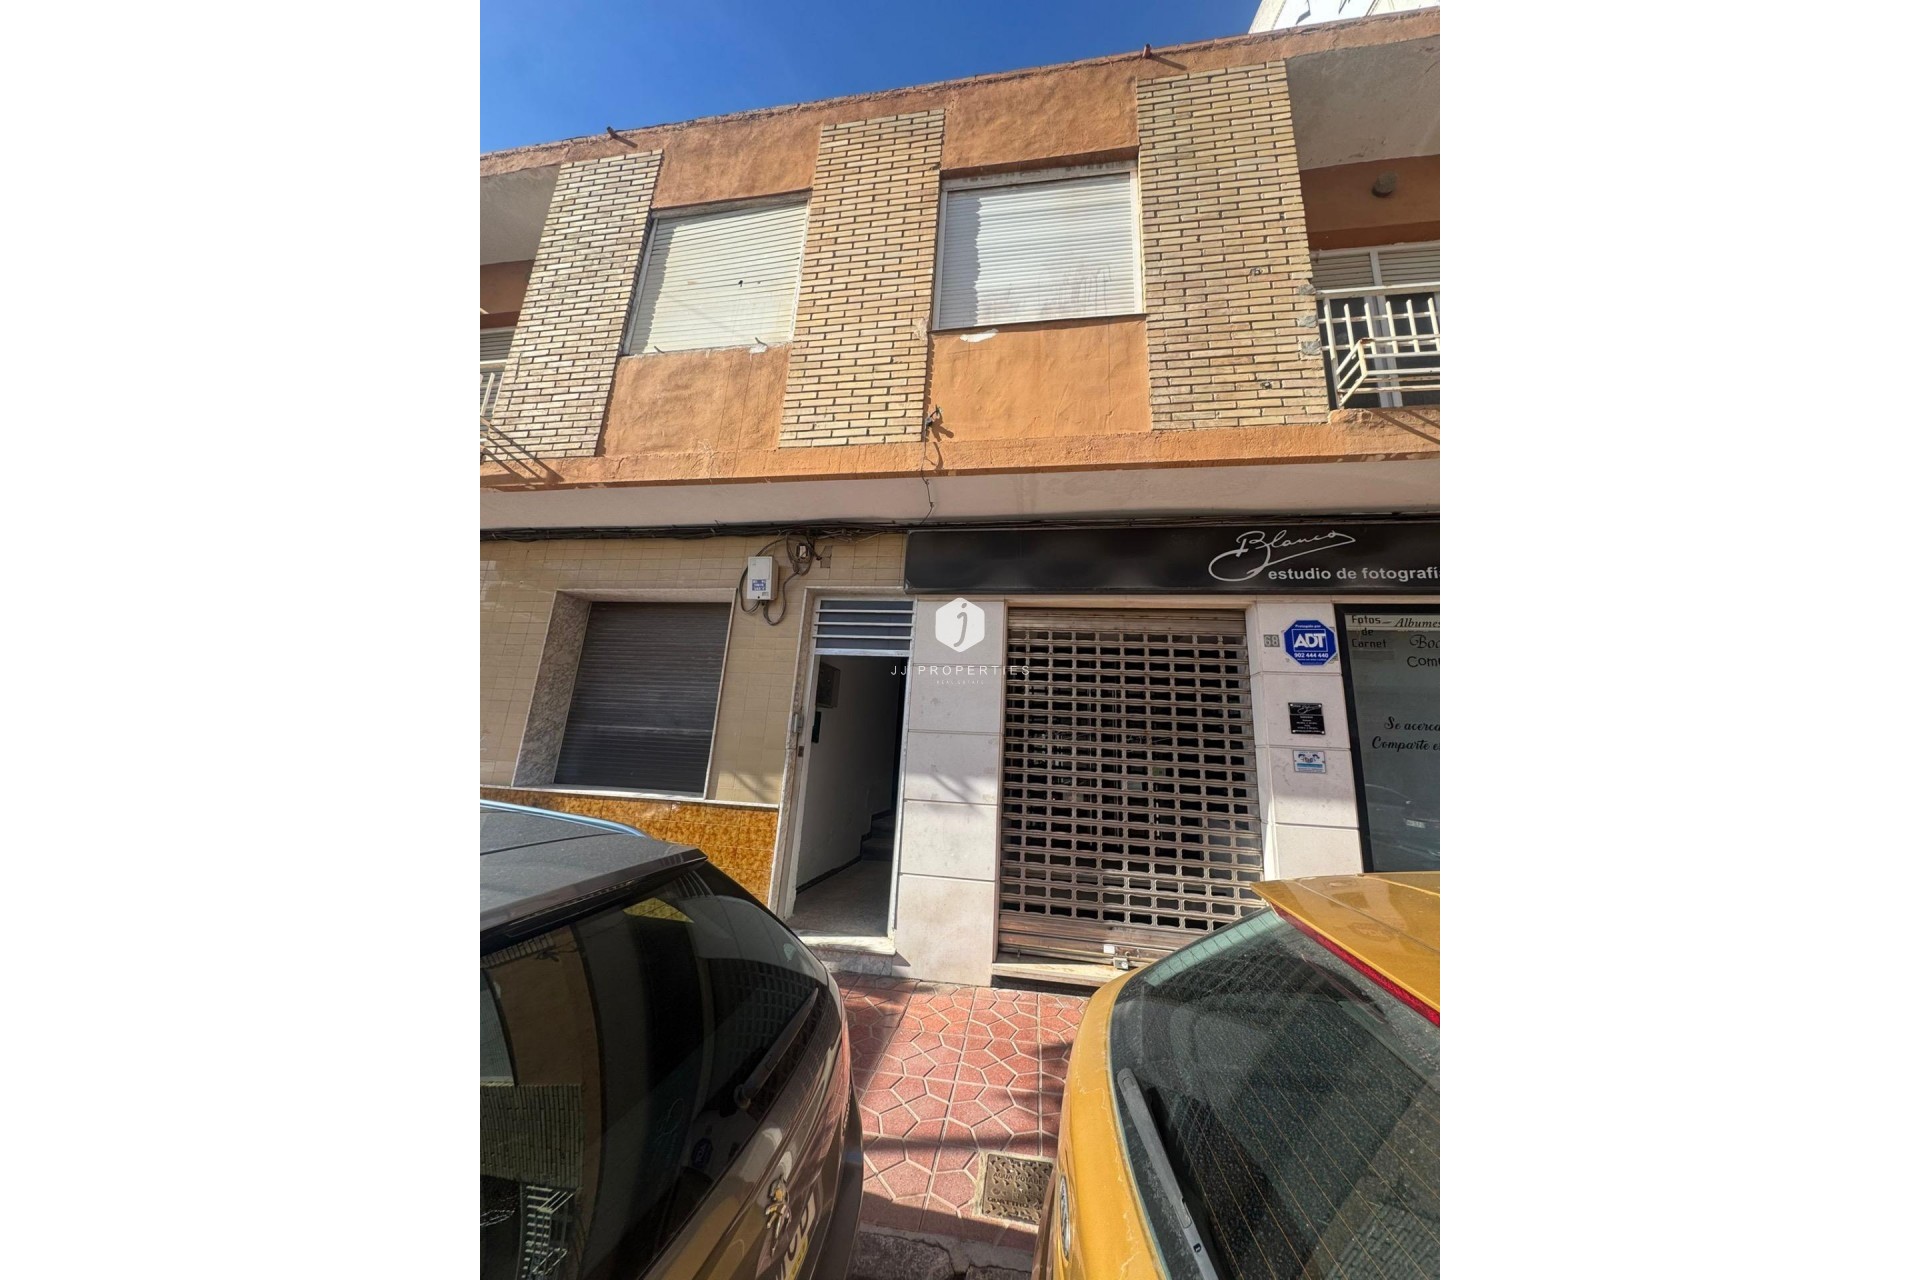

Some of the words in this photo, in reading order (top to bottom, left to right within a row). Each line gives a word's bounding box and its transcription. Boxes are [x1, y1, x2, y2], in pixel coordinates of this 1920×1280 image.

[1268, 568, 1331, 580] estudio
[1336, 567, 1357, 580] de
[1362, 566, 1440, 582] fotografí
[1351, 614, 1381, 625] Fotos
[1362, 627, 1374, 636] de
[1264, 634, 1279, 647] 68
[1293, 633, 1327, 648] ADT
[1406, 655, 1440, 668] Com
[1384, 716, 1401, 730] Se
[1371, 735, 1430, 752] Comparte
[1432, 743, 1440, 751] e
